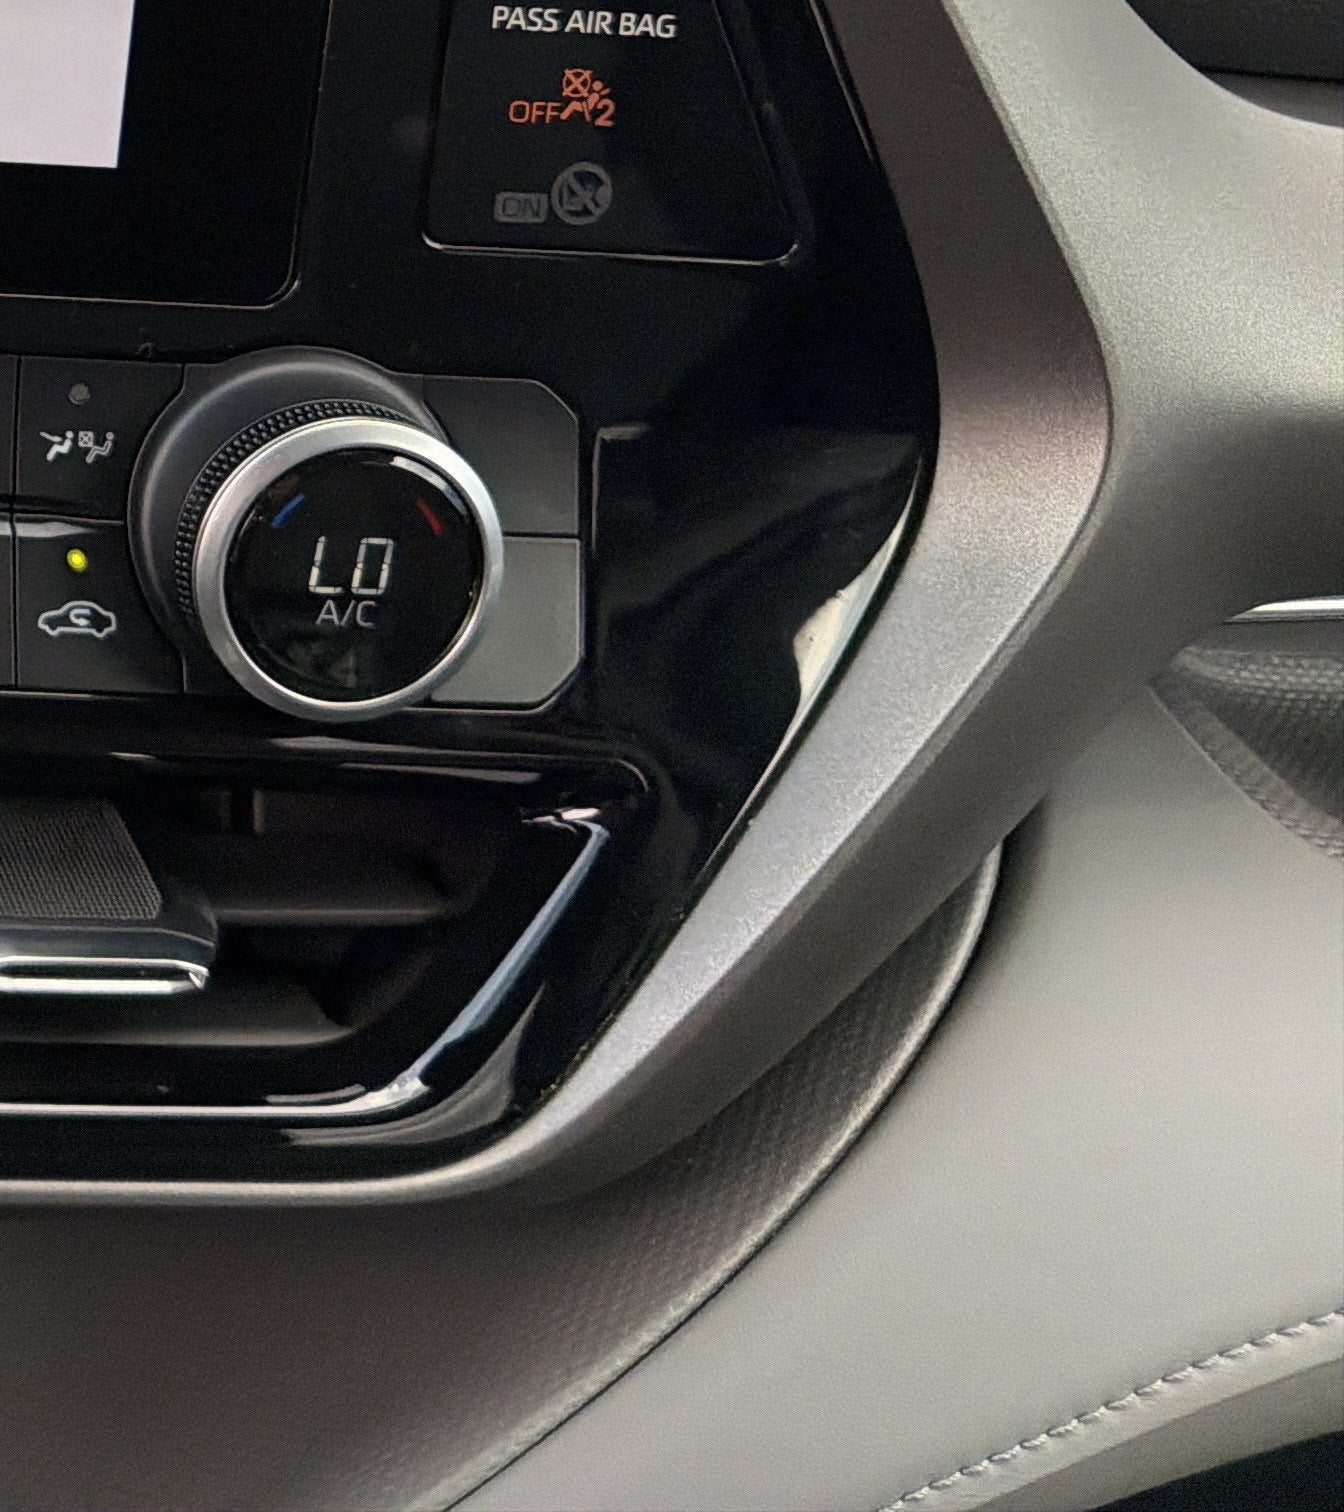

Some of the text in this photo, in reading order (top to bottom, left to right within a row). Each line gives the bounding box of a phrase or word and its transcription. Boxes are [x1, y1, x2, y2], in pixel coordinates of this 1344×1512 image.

[491, 5, 677, 39] PASS AIR BAG
[508, 100, 561, 124] OFF
[502, 196, 543, 220] ON
[308, 535, 395, 596] LO
[315, 598, 377, 628] A/C
